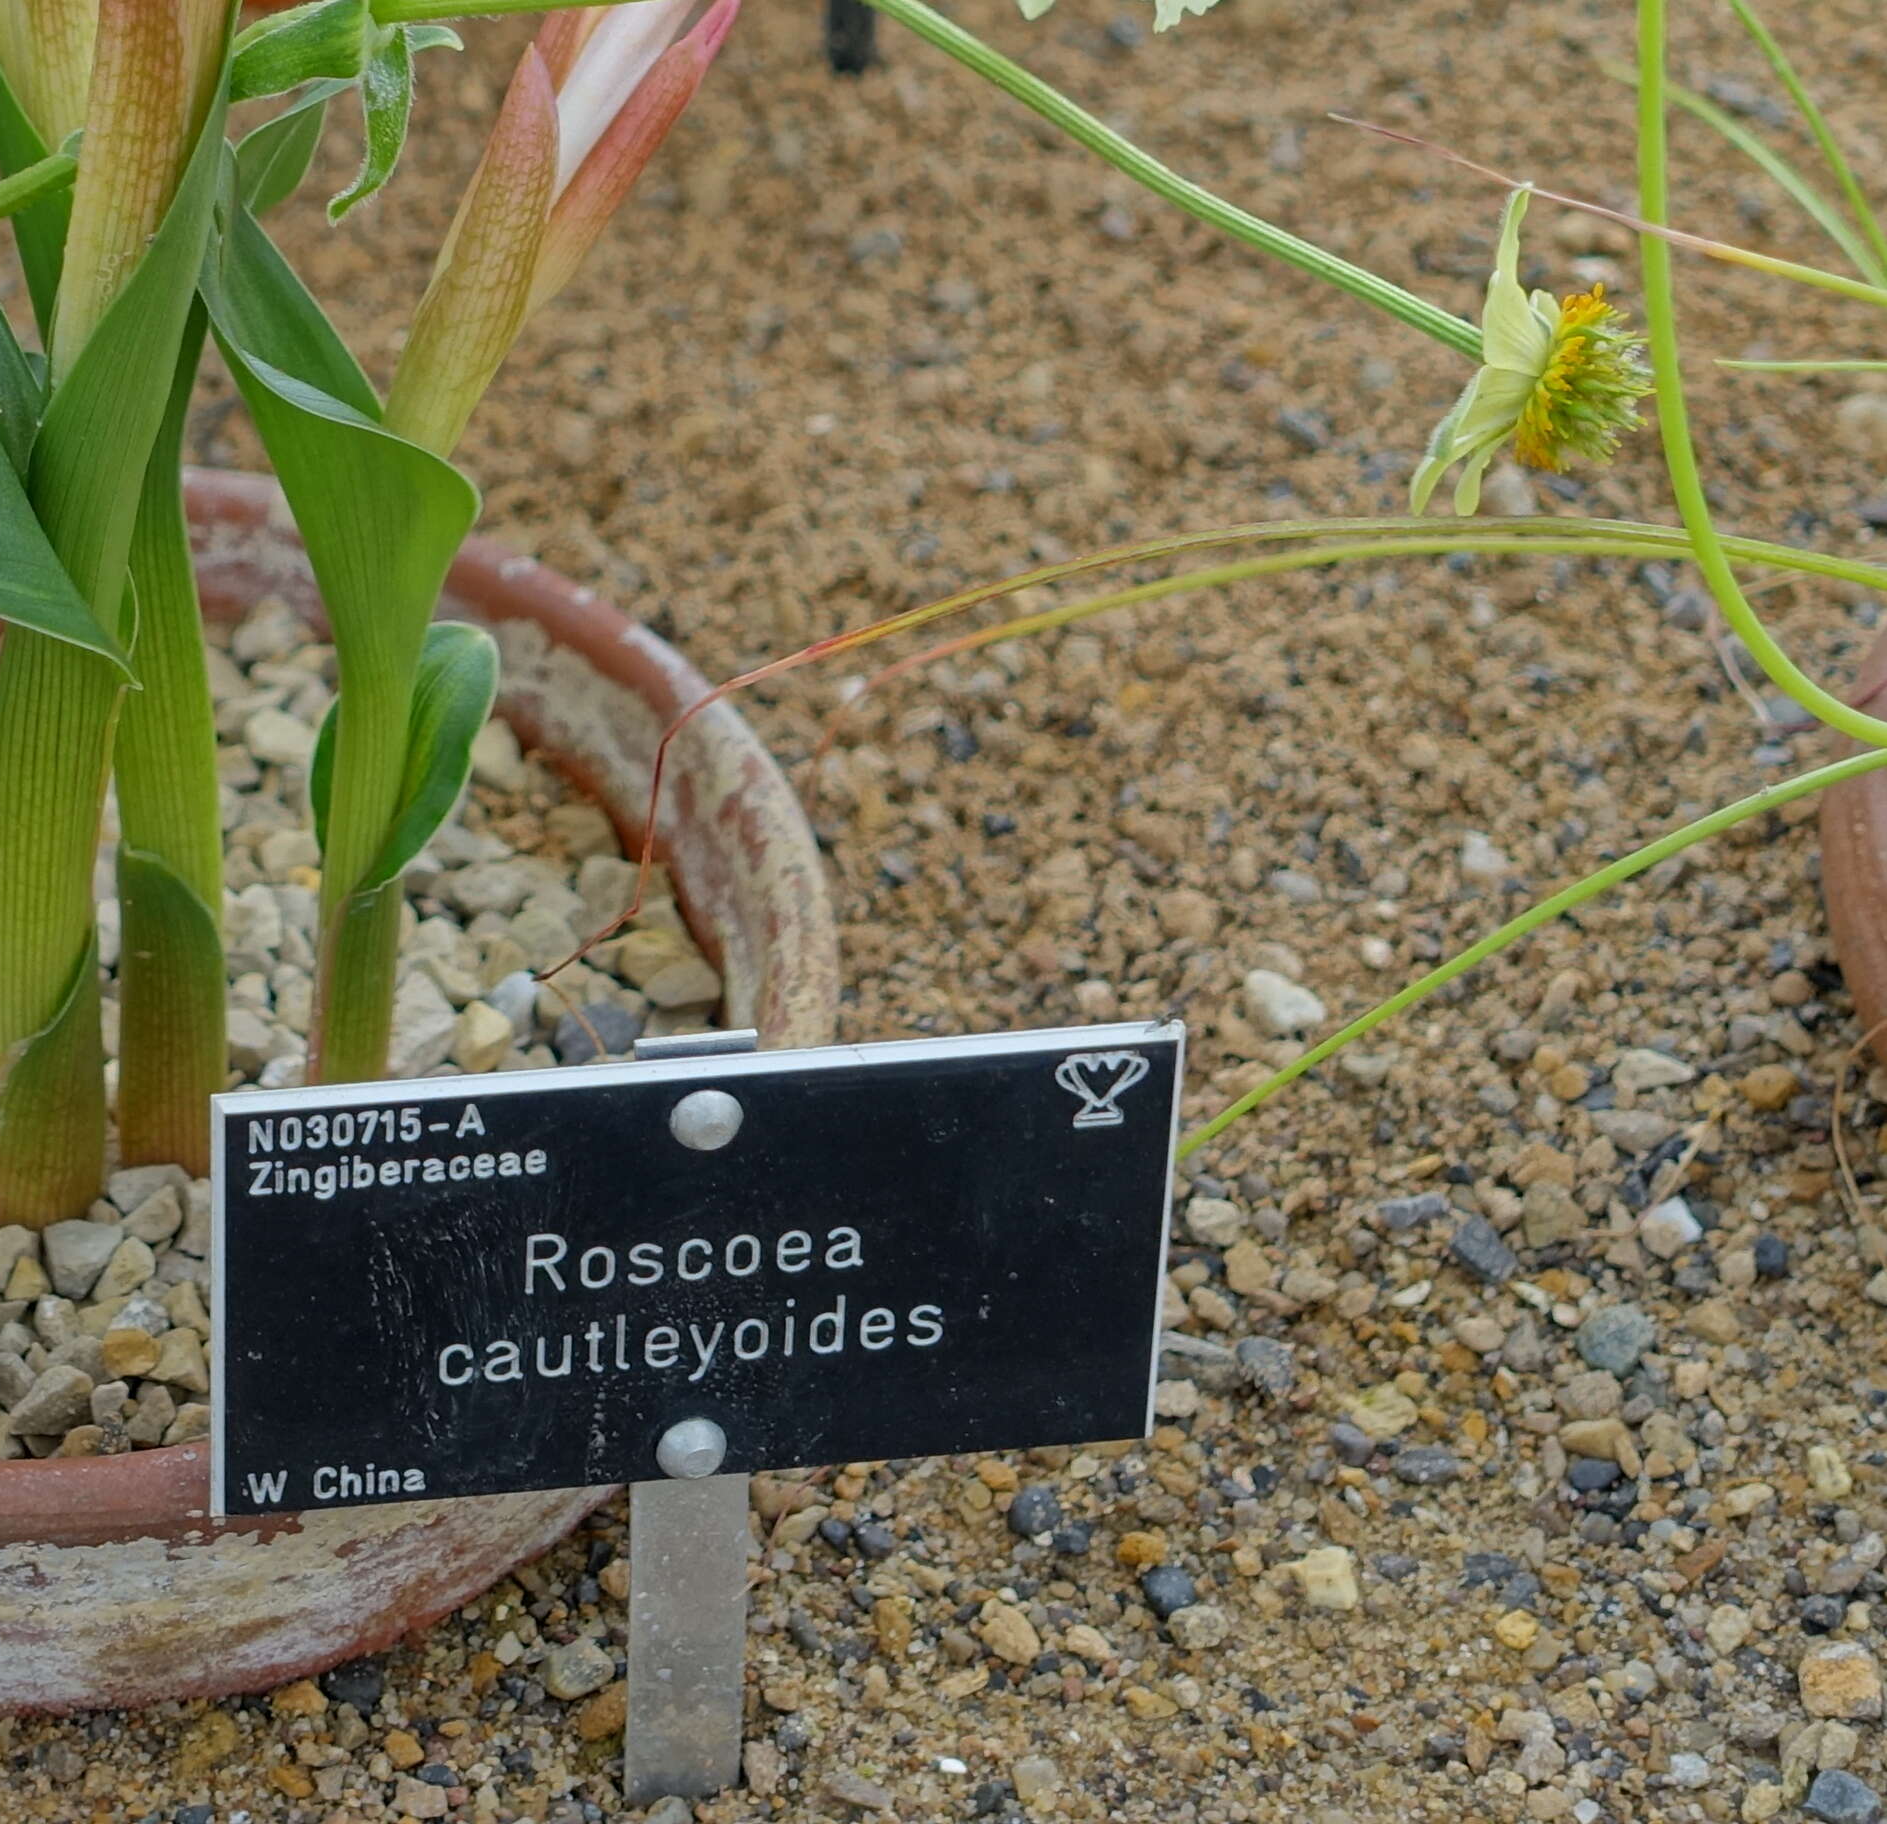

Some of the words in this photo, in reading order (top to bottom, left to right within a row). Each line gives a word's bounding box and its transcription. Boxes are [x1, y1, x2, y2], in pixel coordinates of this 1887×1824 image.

[248, 1104, 486, 1154] N030715-A
[248, 1146, 548, 1199] Zingiberaceae
[524, 1226, 865, 1295] Roscoea
[437, 1295, 946, 1387] cautleyoides
[248, 1471, 287, 1505] W
[313, 1462, 426, 1499] China
